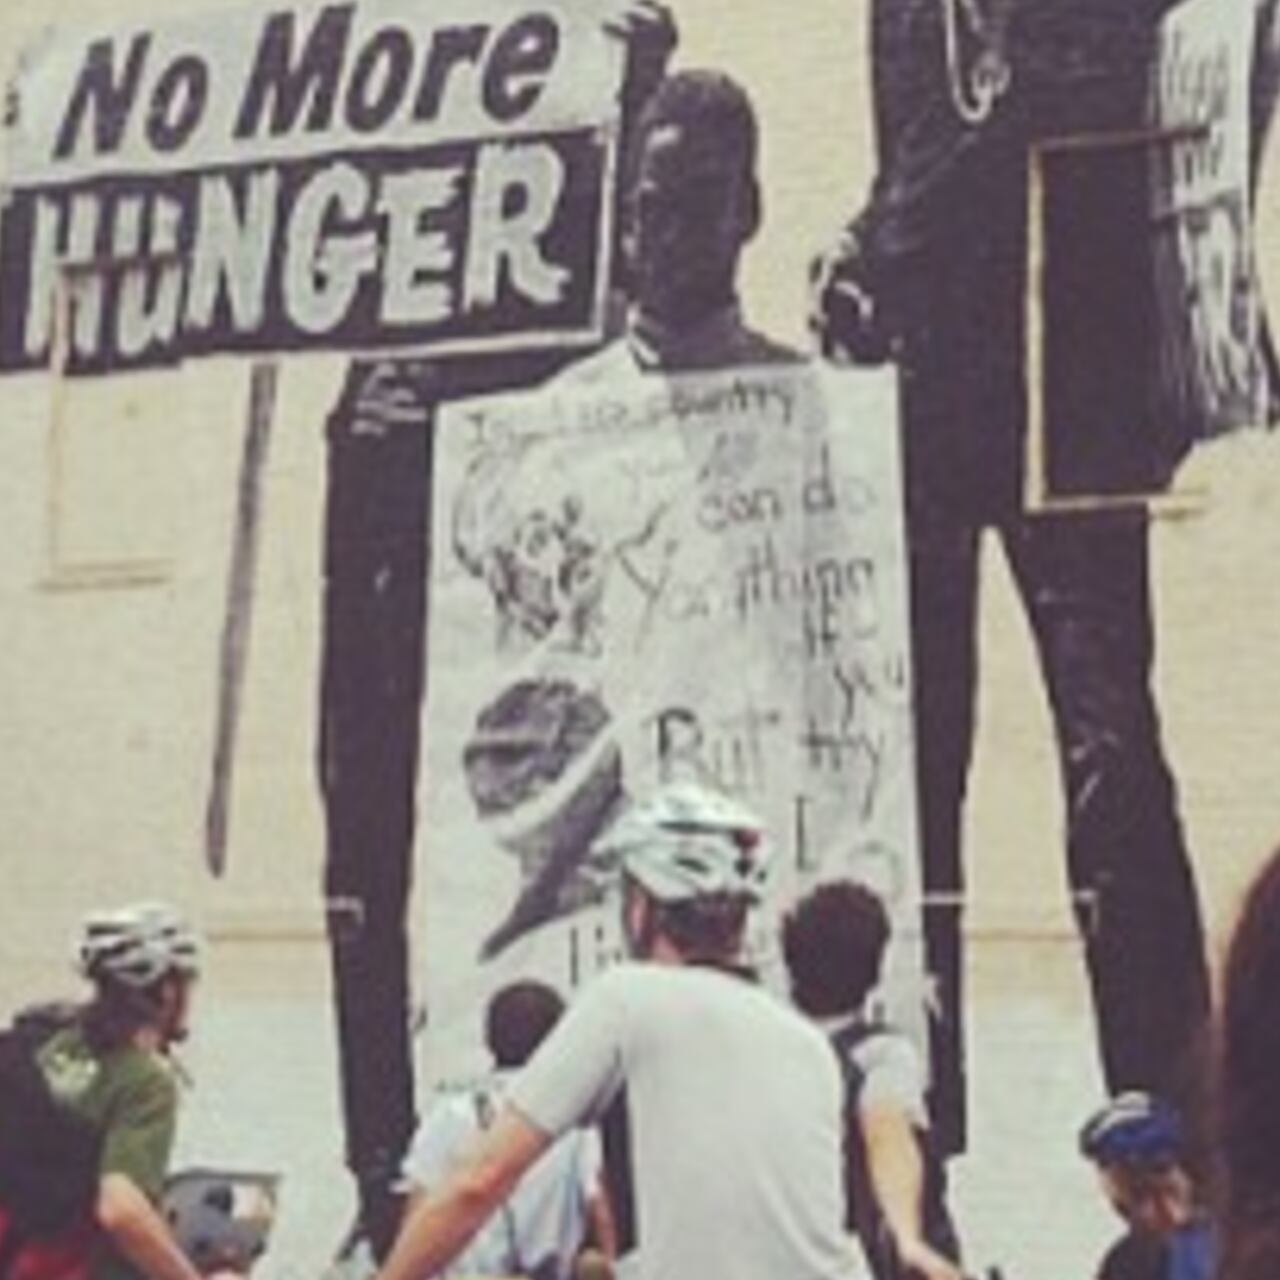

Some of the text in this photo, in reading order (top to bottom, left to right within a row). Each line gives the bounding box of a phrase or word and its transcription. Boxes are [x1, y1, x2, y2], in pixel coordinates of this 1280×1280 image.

[51, 2, 560, 160] No More
[23, 142, 571, 358] HUNGER
